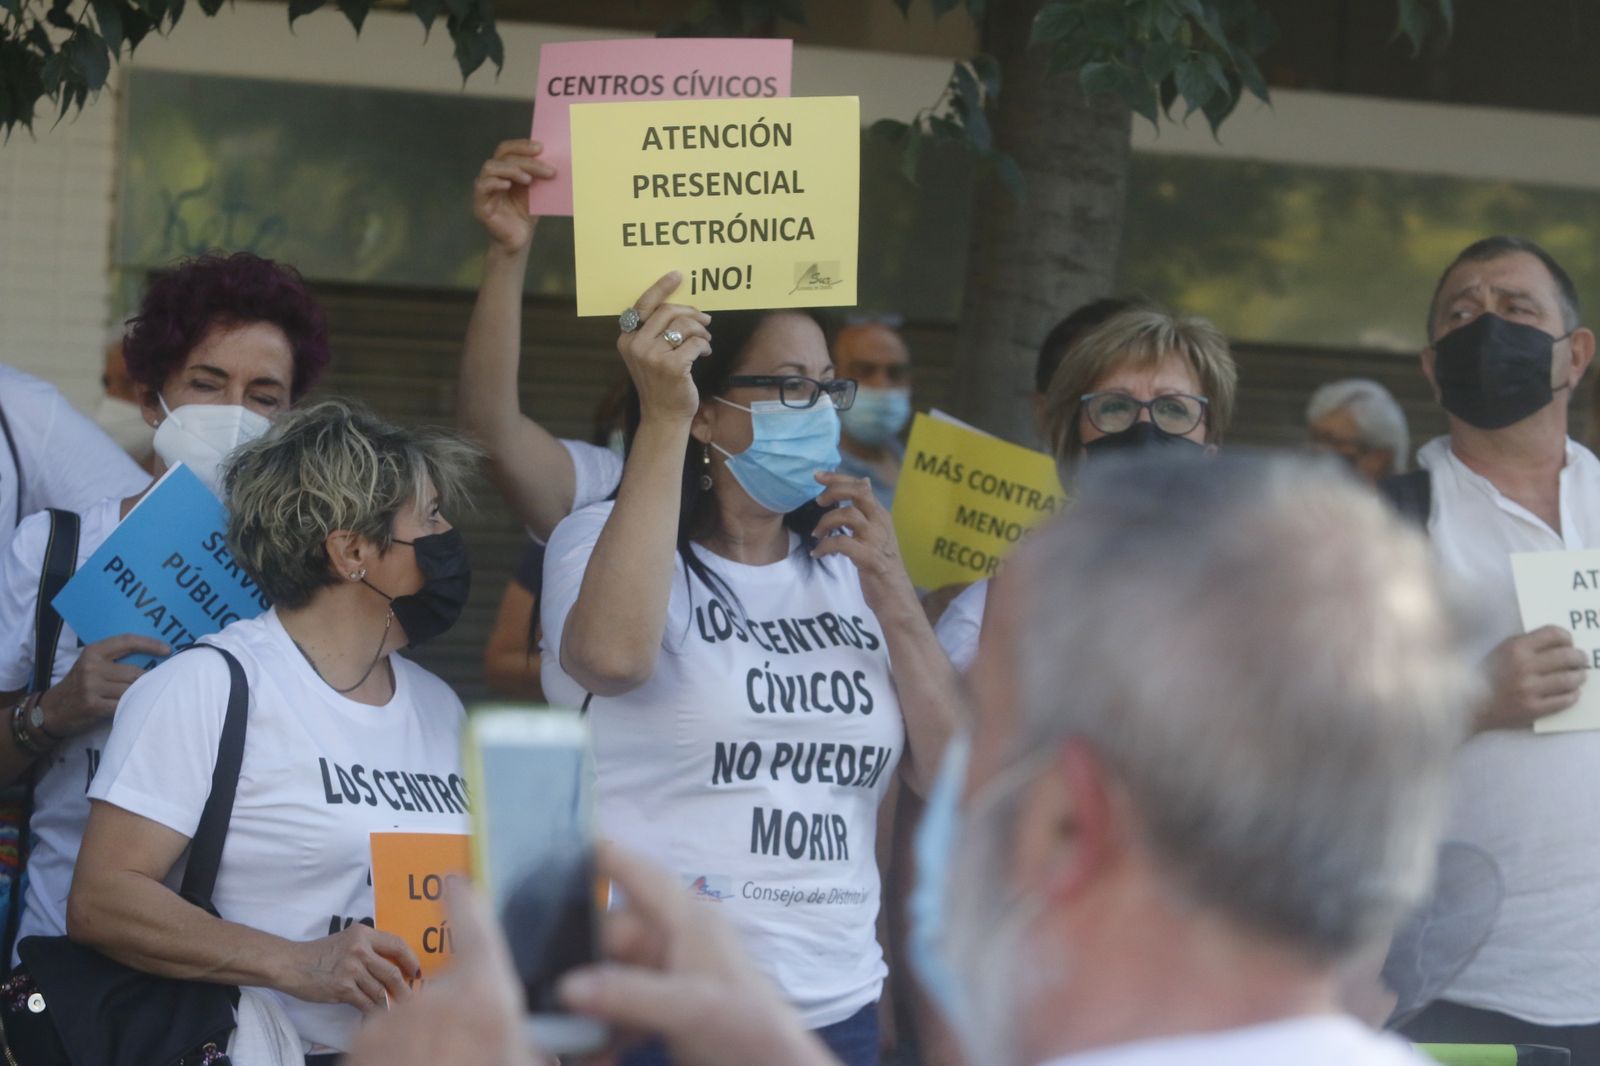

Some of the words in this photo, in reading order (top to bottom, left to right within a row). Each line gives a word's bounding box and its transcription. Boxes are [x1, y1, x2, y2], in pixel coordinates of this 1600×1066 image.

[547, 75, 664, 97] CENTROS
[673, 69, 777, 98] CÍVICOS
[641, 117, 792, 151] ATENCIÓN
[632, 170, 805, 199] PRESENCIAL
[621, 212, 815, 247] ELECTRÓNICA
[691, 264, 752, 295] ¡NO!
[913, 451, 966, 484] MÁS
[968, 468, 1068, 515] CONTRA
[932, 536, 1004, 577] RECOR
[696, 598, 748, 643] LOS
[746, 611, 880, 655] CENTROS
[746, 661, 873, 715] CÍVICOS
[319, 757, 378, 807] LOS
[712, 741, 761, 785] NO
[770, 742, 892, 789] PUEDEN
[750, 806, 848, 861] MORIR
[408, 874, 455, 901] LO
[742, 880, 804, 908] Consejo
[806, 887, 826, 905] de
